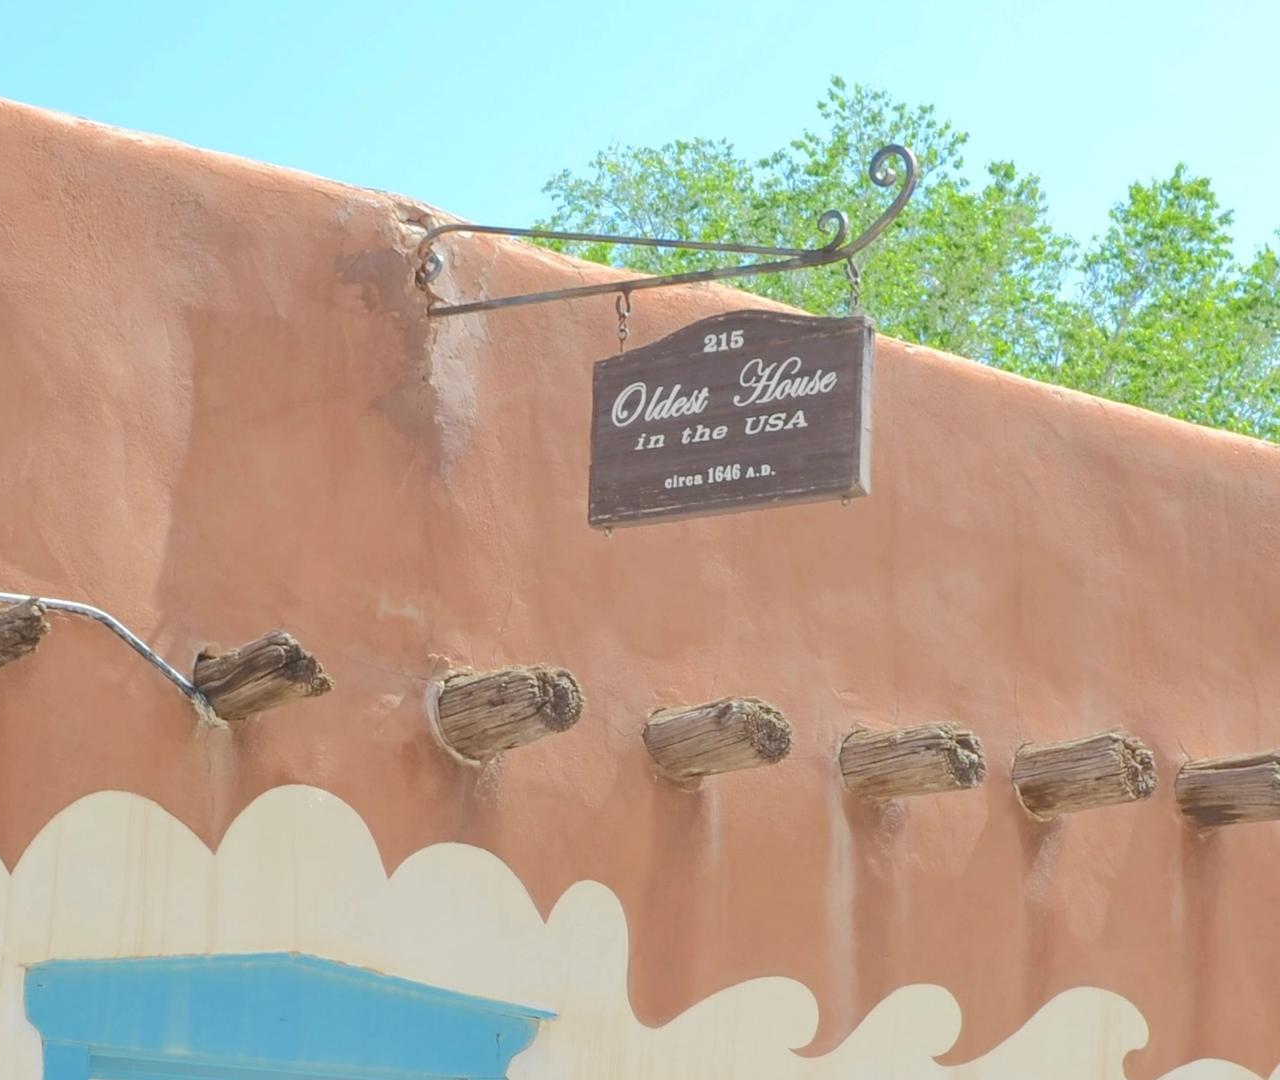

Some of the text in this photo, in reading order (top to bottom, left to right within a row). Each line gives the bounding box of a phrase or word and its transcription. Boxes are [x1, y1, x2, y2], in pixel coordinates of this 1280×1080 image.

[703, 330, 744, 352] 215
[611, 356, 838, 427] Oldest House
[635, 410, 809, 451] in the USA
[665, 464, 776, 490] circa 1646 A.D.
